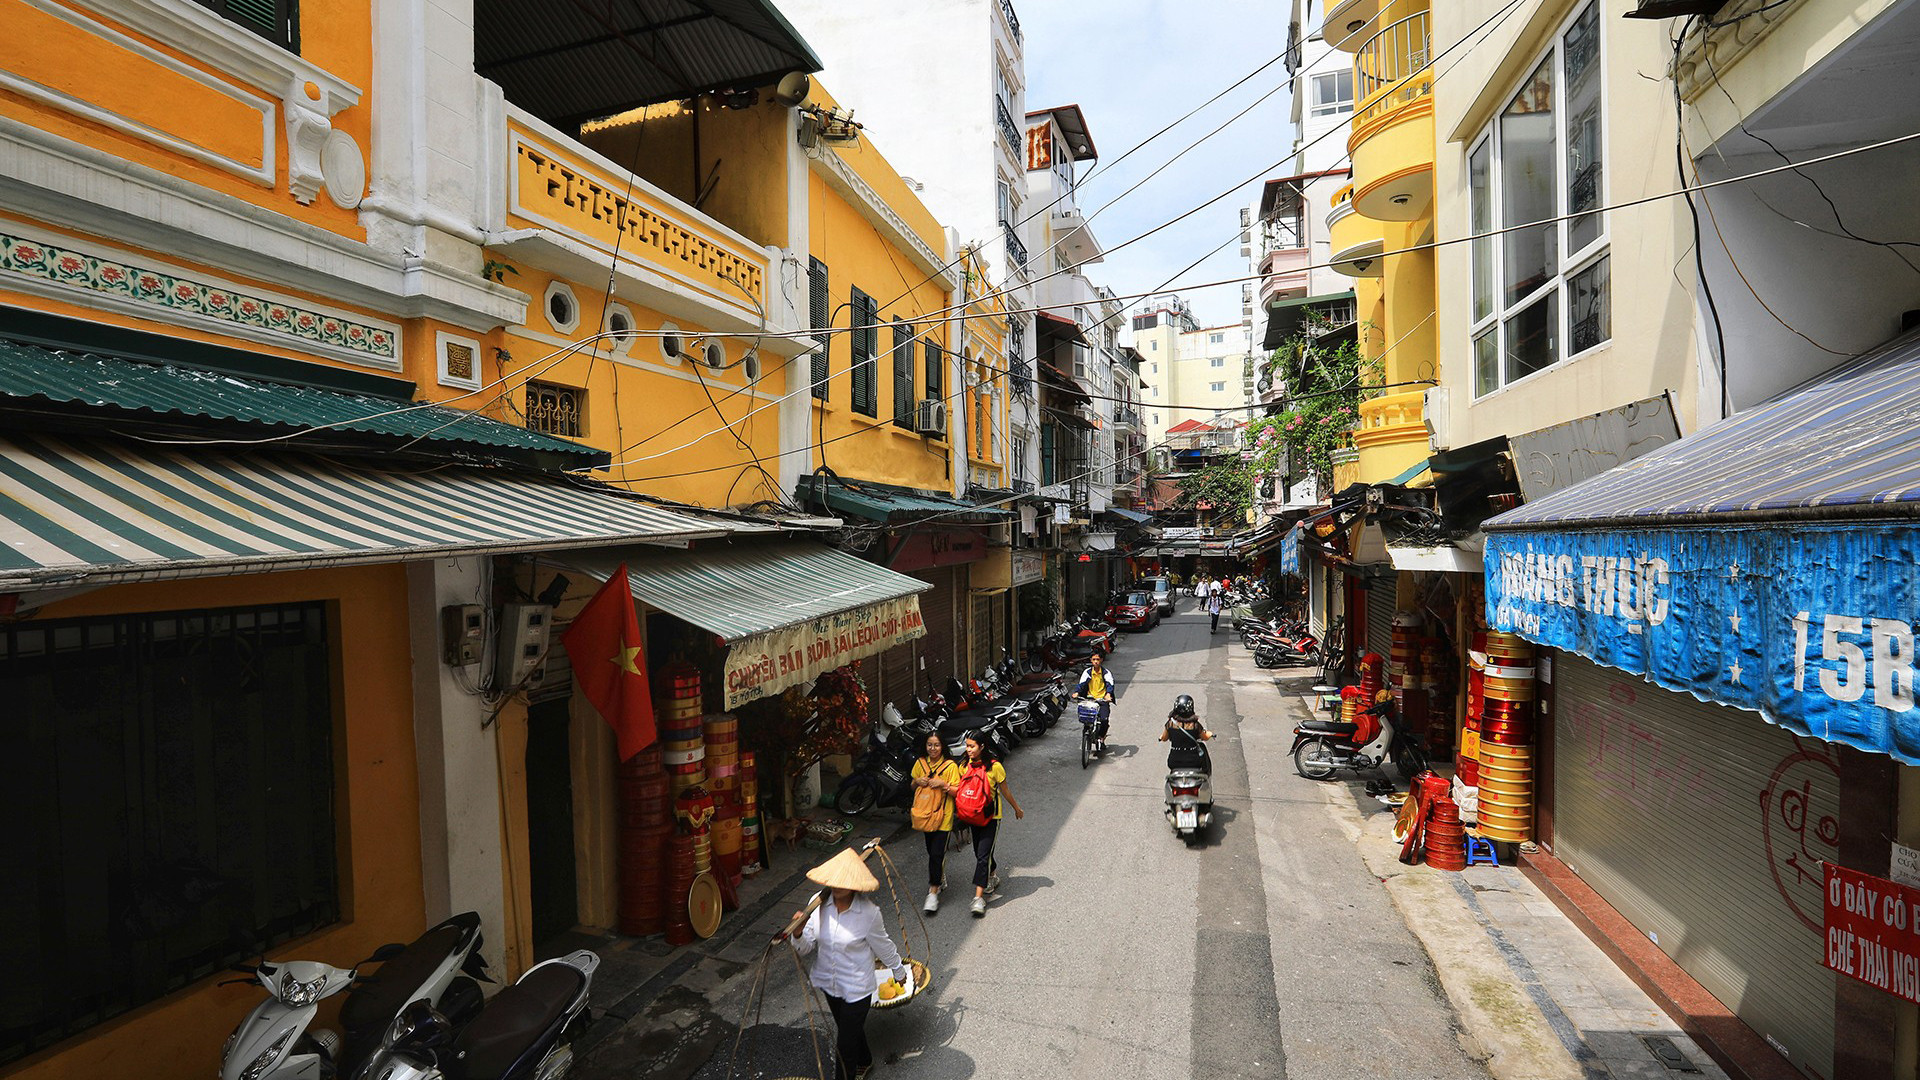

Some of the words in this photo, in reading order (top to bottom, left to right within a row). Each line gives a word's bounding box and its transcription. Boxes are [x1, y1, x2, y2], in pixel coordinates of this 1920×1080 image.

[1582, 551, 1670, 634] THỰC
[779, 645, 803, 676] BÁN
[1792, 610, 1915, 713] 15B
[1899, 847, 1917, 859] CHO
[1829, 867, 1841, 907] Ở
[1845, 881, 1878, 920] ĐÂY
[1883, 893, 1906, 931] CÓ
[1829, 923, 1854, 975] CHÈ
[1858, 935, 1889, 989] THÁI
